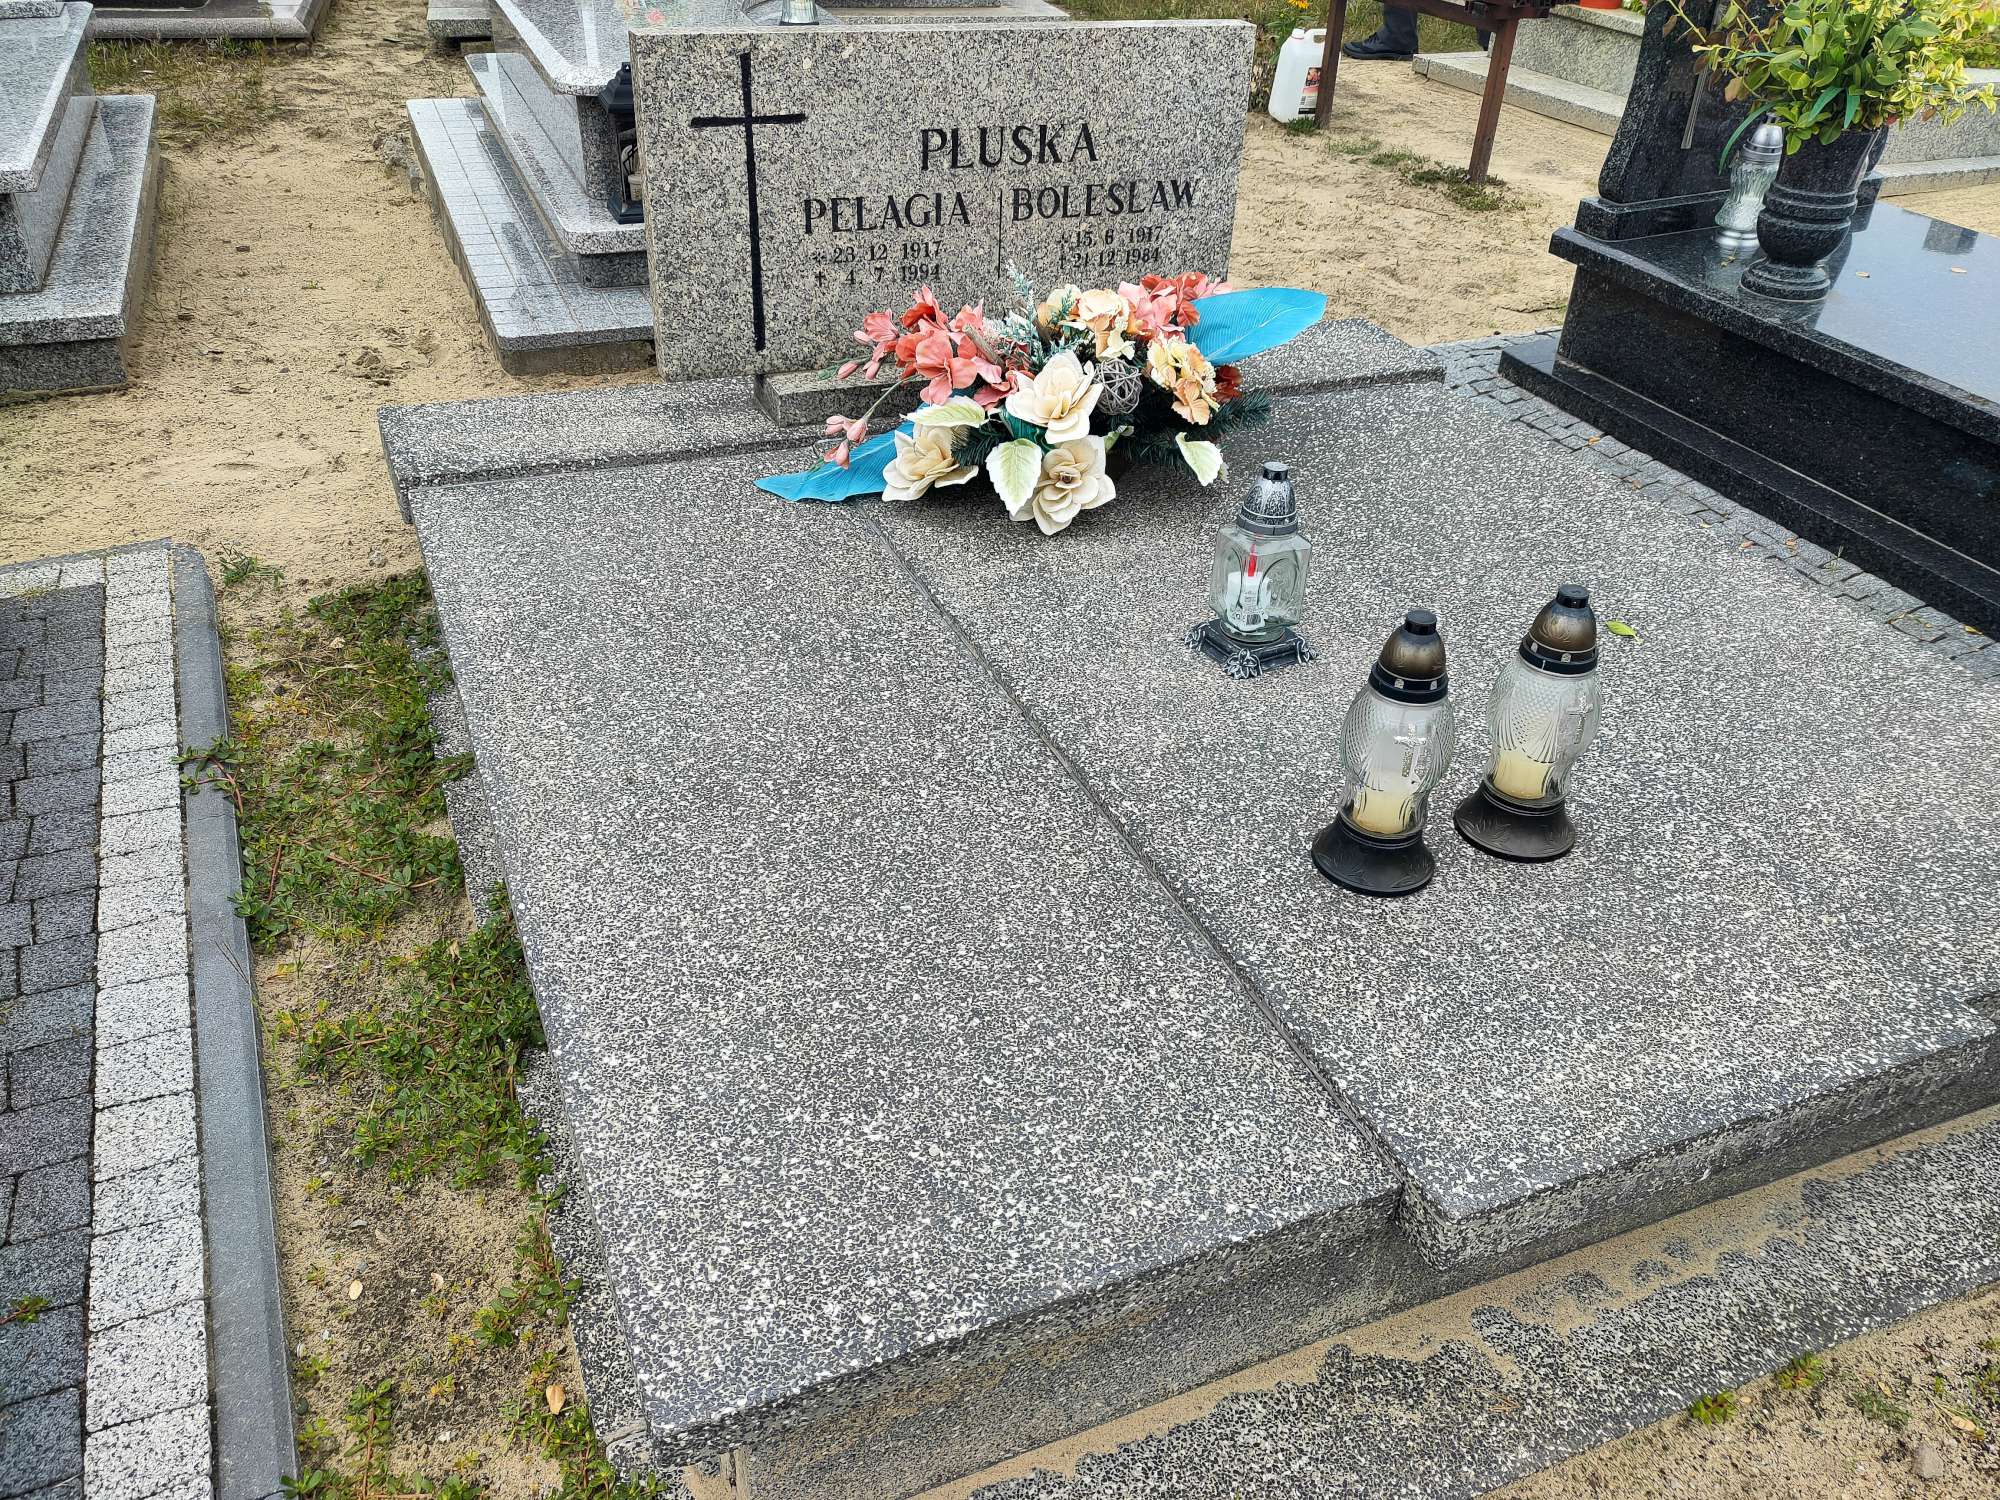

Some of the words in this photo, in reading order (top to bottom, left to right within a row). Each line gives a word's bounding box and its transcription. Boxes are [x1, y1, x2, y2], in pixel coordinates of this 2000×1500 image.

[921, 123, 1098, 171] PŁUSKA
[803, 191, 971, 234] PELAGIA
[1126, 226, 1162, 243] 1917
[902, 241, 943, 259] 1917
[1125, 248, 1159, 264] 1984
[900, 264, 940, 281] 1994
